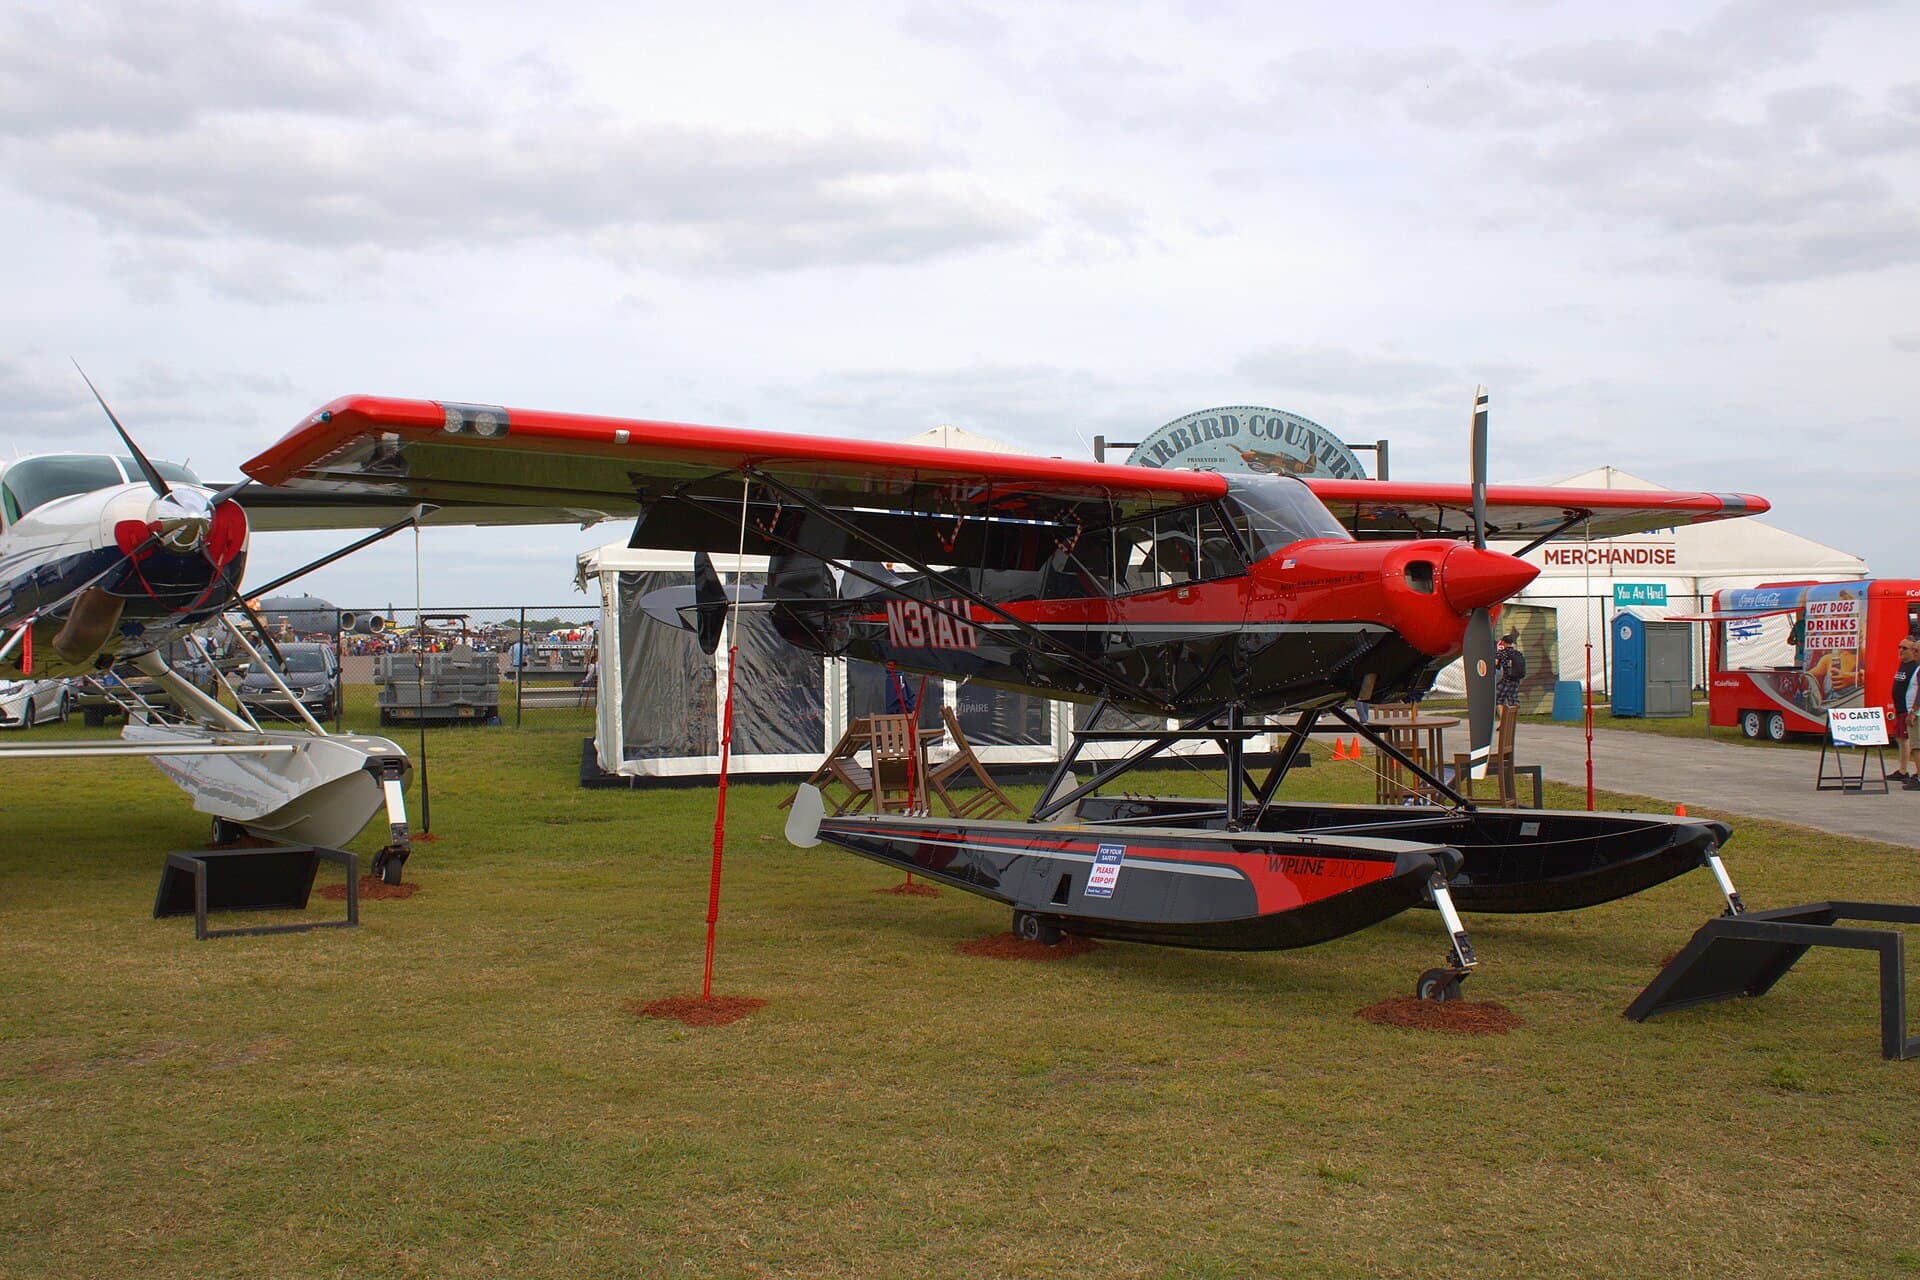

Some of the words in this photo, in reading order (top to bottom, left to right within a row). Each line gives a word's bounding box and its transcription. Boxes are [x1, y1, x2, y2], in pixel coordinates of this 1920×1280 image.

[1139, 414, 1240, 468] ARBIRD
[1544, 548, 1676, 565] MERCHANDISE
[1617, 585, 1631, 600] You
[1633, 585, 1645, 600] Are
[1646, 585, 1665, 600] Here!
[1810, 603, 1828, 613] HOT
[1830, 601, 1855, 612] DOGS
[886, 598, 977, 650] N31AH
[1807, 619, 1856, 631] DRINKS
[1806, 637, 1820, 648] ICE
[1822, 636, 1855, 648] CREAM
[1832, 712, 1847, 720] NO
[1849, 711, 1881, 720] CARTS
[1837, 724, 1881, 732] Pedestrians
[1850, 733, 1870, 741] ONLY
[1096, 866, 1114, 874] PLEASE
[1268, 856, 1326, 876] WIPLINE
[1328, 860, 1366, 880] 2100
